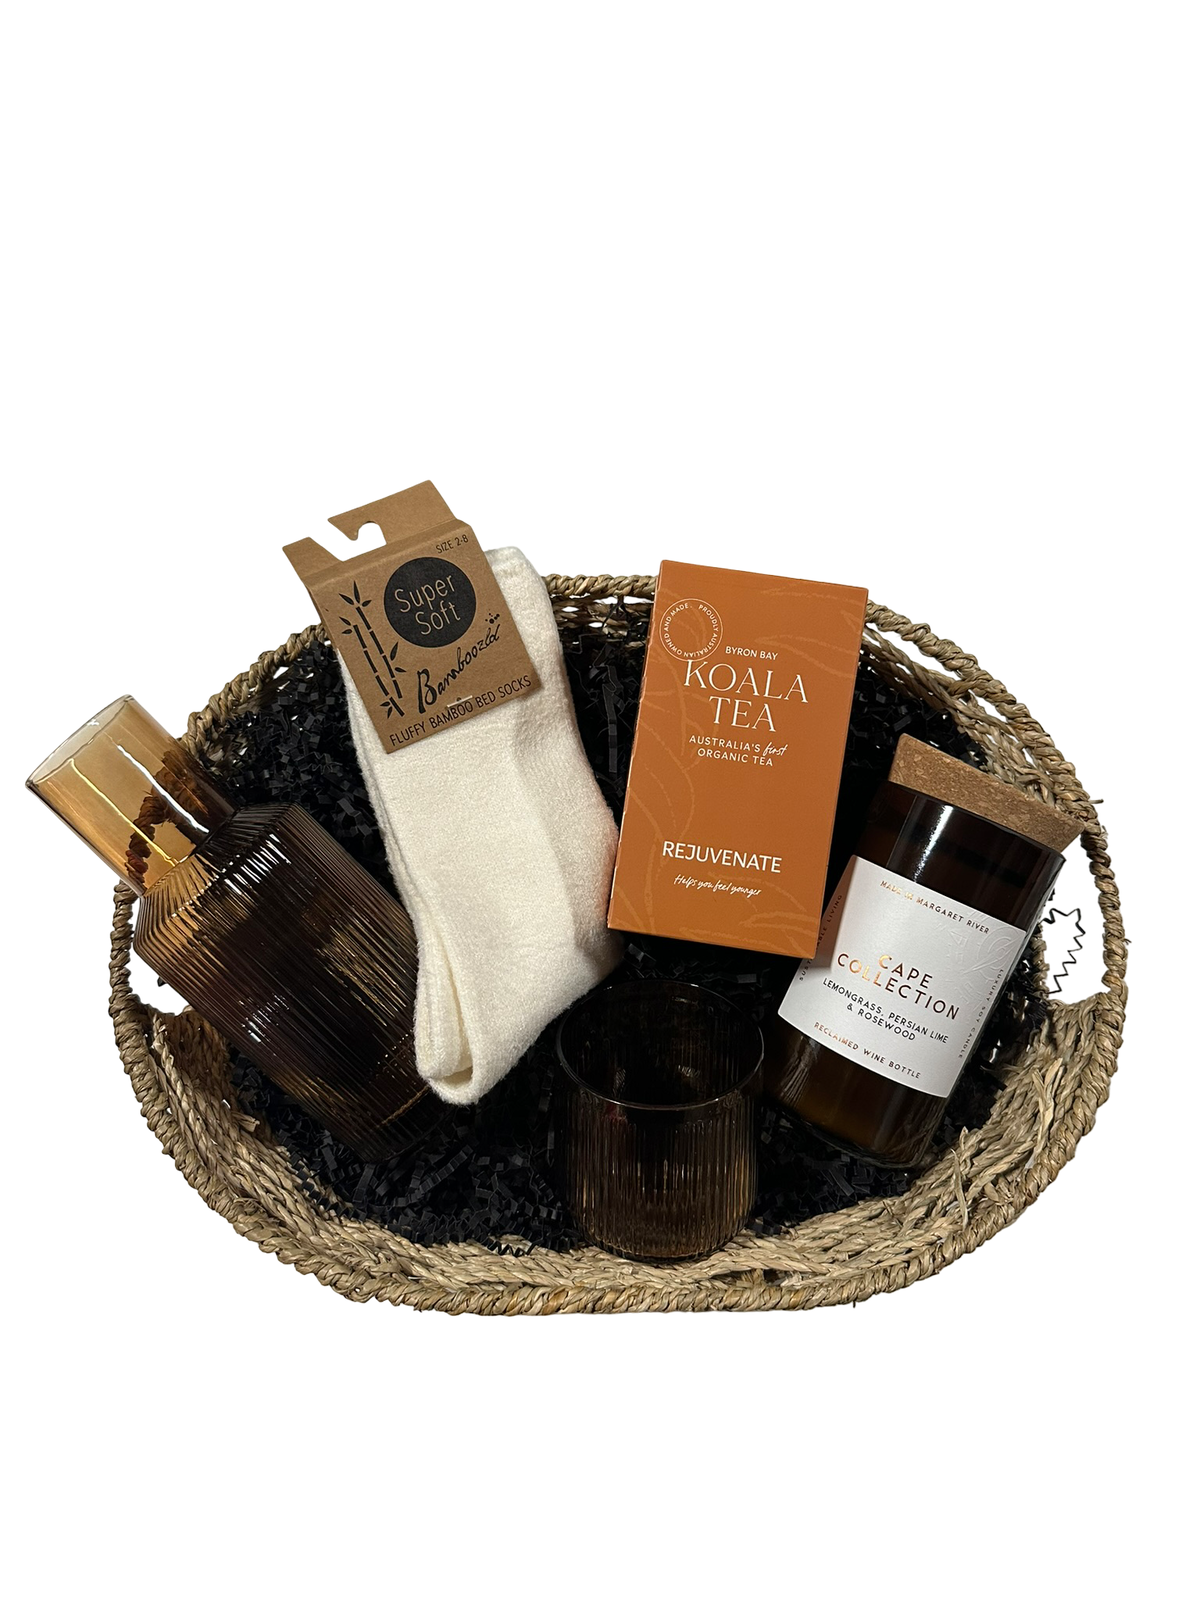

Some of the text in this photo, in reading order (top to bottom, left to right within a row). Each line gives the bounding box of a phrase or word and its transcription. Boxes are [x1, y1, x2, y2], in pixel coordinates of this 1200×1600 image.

[436, 540, 454, 554] SIZE
[394, 575, 455, 613] Super
[415, 602, 461, 635] Soft
[664, 616, 672, 632] AND
[698, 604, 719, 632] PROUDLY
[664, 633, 683, 655] OWNED
[683, 633, 718, 658] AUSTRALIAN
[725, 645, 778, 661] BYRON BAY
[684, 659, 809, 704] KOALA
[389, 675, 532, 746] FLUFFY BAMBOO BED SOCKS
[709, 695, 776, 732] TEA
[689, 735, 788, 757] AUSTRALIA'S first
[697, 748, 773, 767] ORGANIC TEA
[662, 840, 783, 874] REJUVENATE
[673, 874, 762, 898] Helps you feel younger
[827, 894, 843, 924] LIVING
[880, 880, 903, 896] MADE
[916, 896, 964, 923] MARGARET
[966, 919, 990, 935] RIVER
[837, 953, 960, 1021] COLLECTION
[878, 954, 933, 989] CAPE
[822, 977, 949, 1044] LEMONGRASS, PERSIAN LIME
[846, 1002, 916, 1042] & ROSEWOOD
[958, 969, 1004, 1059] LUXURY SOY CANDLE
[813, 1021, 921, 1079] RECLAIMED WINE BOTTLE
